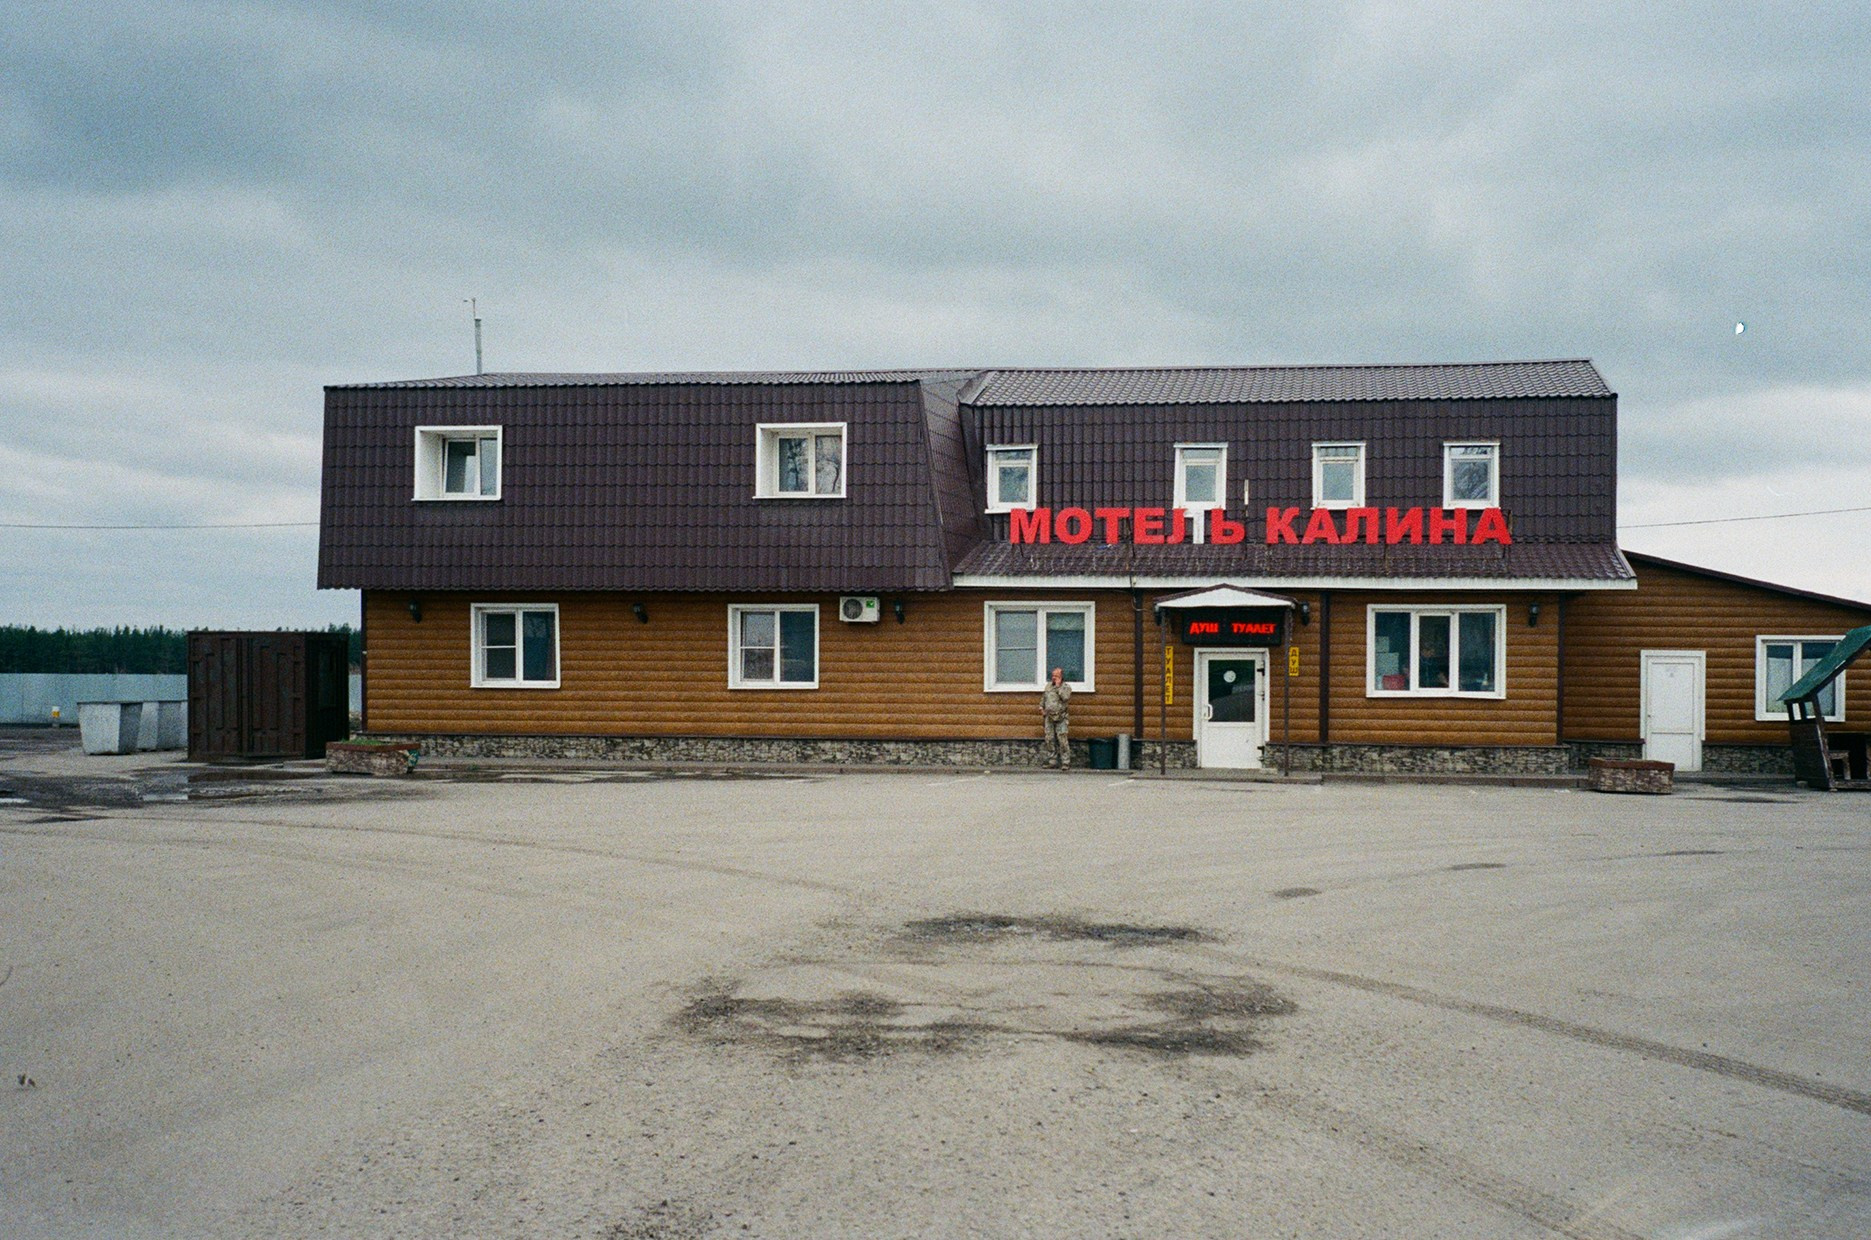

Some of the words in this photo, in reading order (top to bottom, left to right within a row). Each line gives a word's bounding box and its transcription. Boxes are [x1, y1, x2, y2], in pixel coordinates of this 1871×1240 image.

[1009, 508, 1246, 544] МОТЕЛЬ
[1265, 507, 1513, 545] КАЛИНА
[1189, 622, 1219, 635] ДУШ
[1231, 622, 1276, 634] ТУАЛЕТ
[1165, 647, 1173, 702] ТУАЛЕТ
[1290, 648, 1299, 674] ДУШ
